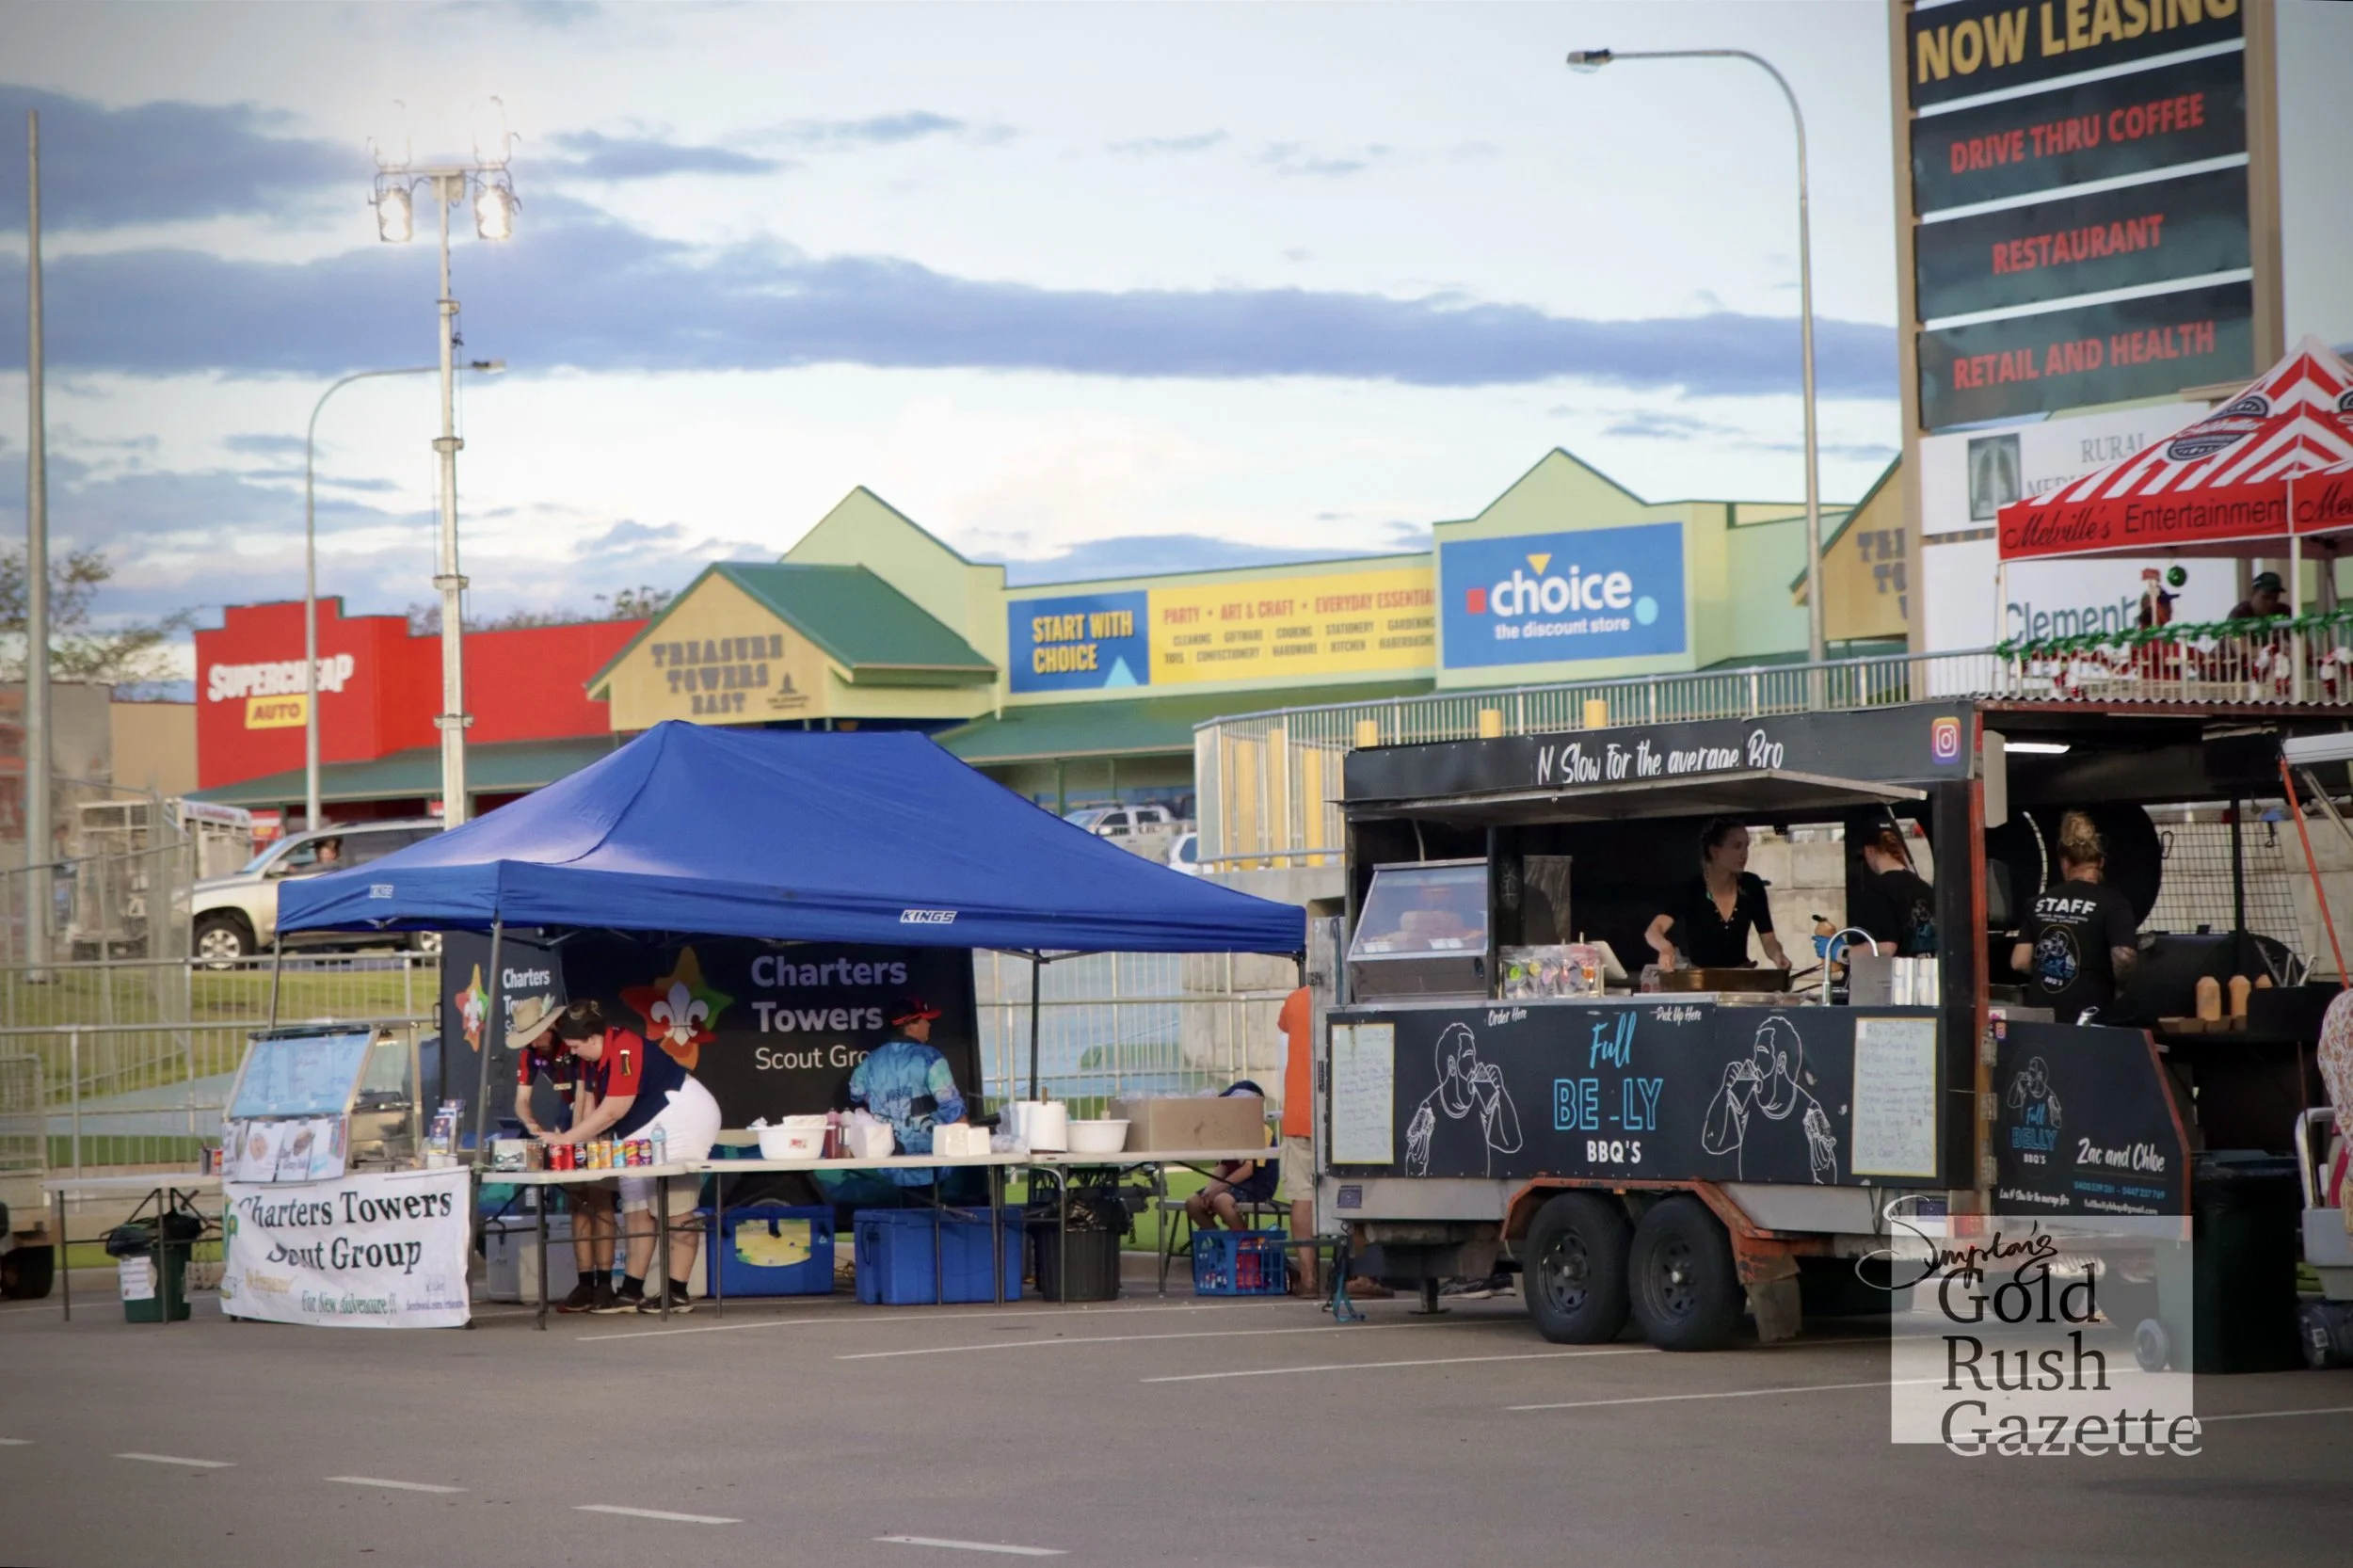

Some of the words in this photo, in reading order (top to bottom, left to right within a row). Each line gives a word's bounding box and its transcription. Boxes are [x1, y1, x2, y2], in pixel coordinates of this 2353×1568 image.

[1916, 8, 2028, 84] NOW
[2041, 0, 2237, 57] LEASING
[1950, 131, 2025, 174] DRIVE
[2030, 114, 2102, 155] THRU
[2107, 93, 2205, 143] COFFEE
[1993, 214, 2164, 275] RESTAURANT
[1953, 347, 2040, 391] RETAIL
[2045, 338, 2103, 374] AND
[2111, 321, 2216, 365] HEALTH
[2003, 505, 2111, 551] Melville's
[2124, 496, 2287, 534] Entertainment
[1491, 565, 1632, 617] choice
[1163, 607, 1200, 625] PARTY
[1221, 603, 1242, 621] ART
[1258, 600, 1294, 617] CRAFT
[1316, 594, 1373, 615] EVERYDAY
[1032, 614, 1085, 644] START
[1088, 610, 1133, 639] WITH
[1495, 624, 1519, 640] the
[1522, 618, 1588, 639] discount
[1590, 616, 1631, 633] store
[651, 633, 784, 667] TREASURE
[1033, 644, 1098, 674] CHOICE
[667, 663, 769, 694] TOWERS
[252, 702, 301, 721] AUTO
[692, 692, 745, 714] EAST
[1561, 743, 1600, 784] Slow
[1637, 739, 1661, 776] the
[1748, 729, 1784, 770] Bro
[902, 911, 957, 922] KINGS
[2034, 897, 2097, 916] STAFF
[502, 968, 551, 989] Charters
[751, 955, 908, 987] Charters
[751, 1001, 884, 1032] Towers
[1487, 1009, 1509, 1027] Order
[1512, 1007, 1528, 1020] Here
[1590, 1011, 1637, 1069] Full
[755, 1047, 824, 1070] Scout
[829, 1045, 871, 1068] Gro
[1587, 1141, 1641, 1163] BBQ'S
[2011, 1127, 2058, 1152] BELLY
[2076, 1138, 2102, 1164] Zac
[2105, 1144, 2131, 1168] and
[2133, 1143, 2166, 1172] Chloe
[340, 1192, 453, 1224] Towers
[331, 1237, 422, 1274] Group
